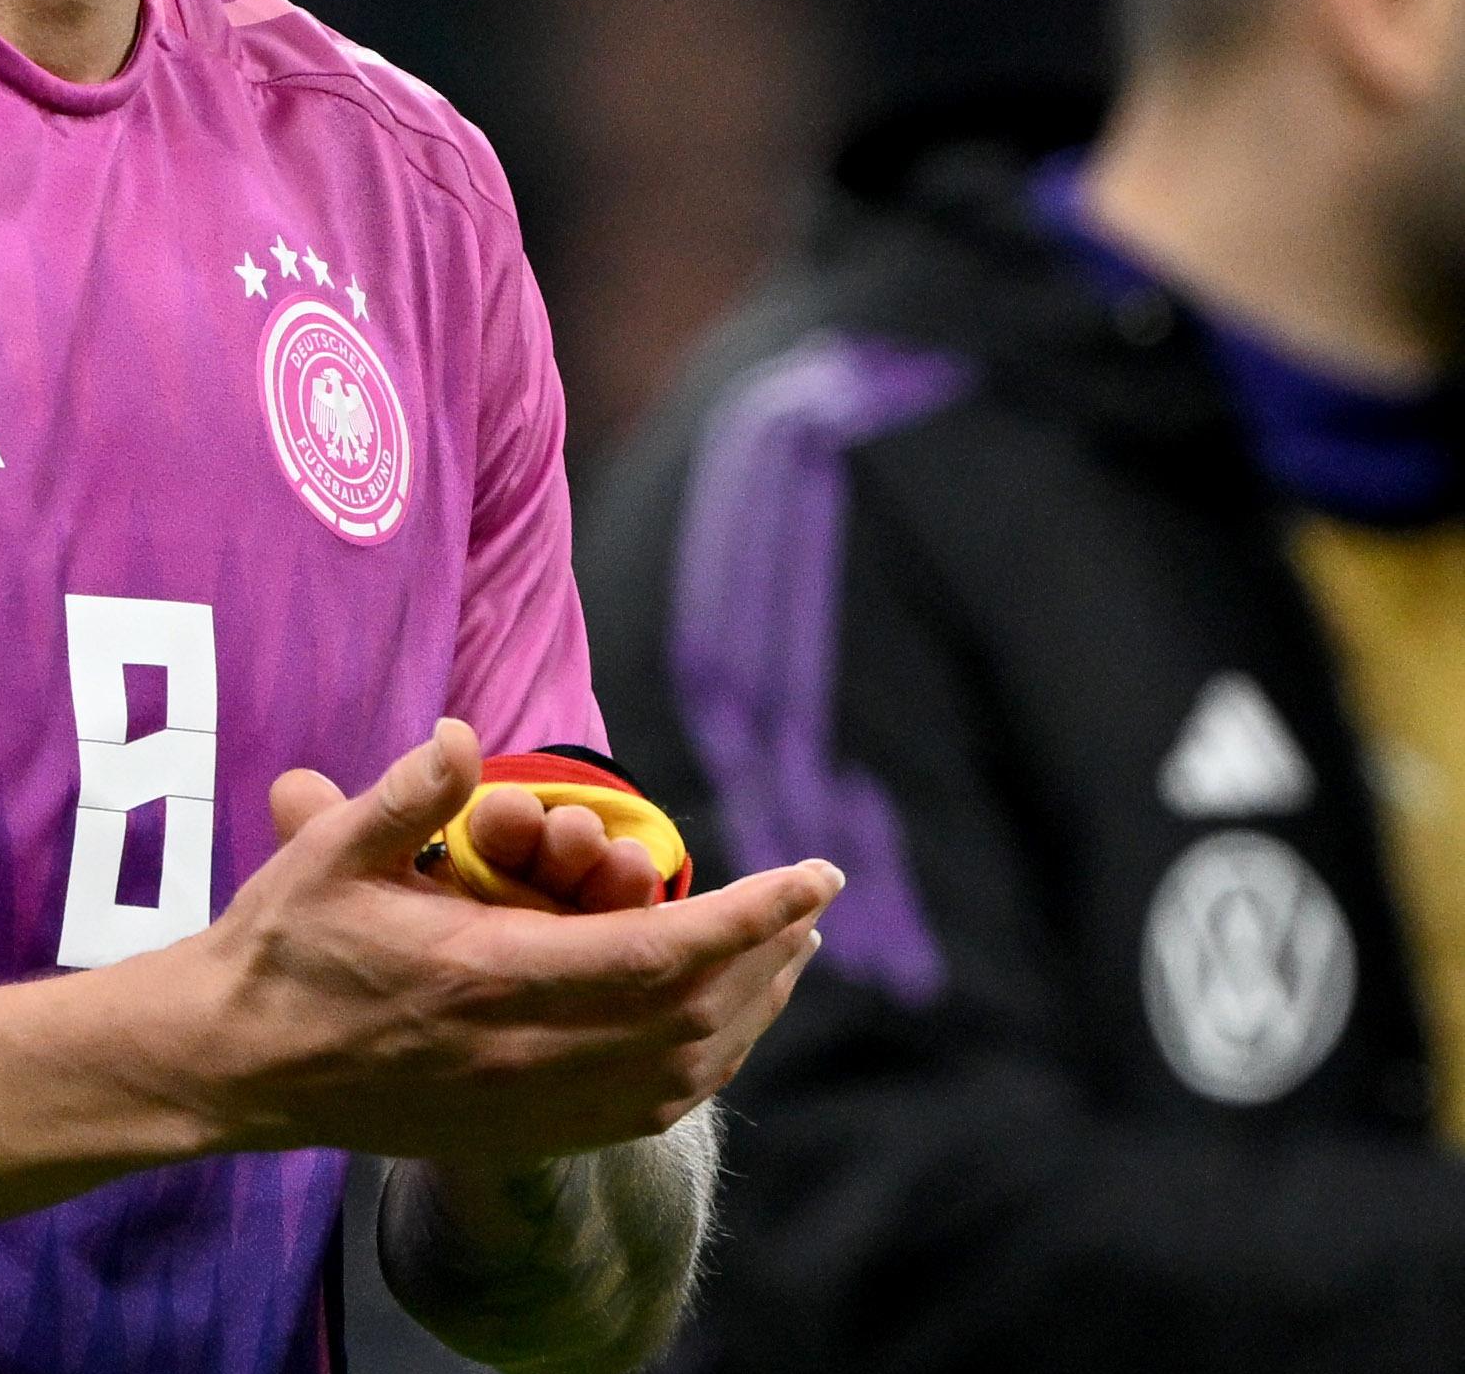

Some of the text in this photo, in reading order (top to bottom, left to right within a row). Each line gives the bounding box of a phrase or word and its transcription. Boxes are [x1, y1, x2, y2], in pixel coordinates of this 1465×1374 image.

[289, 332, 367, 380] DEUTSCHER
[296, 436, 393, 506] FUSSBALL-BUND
[57, 593, 218, 969] 8
